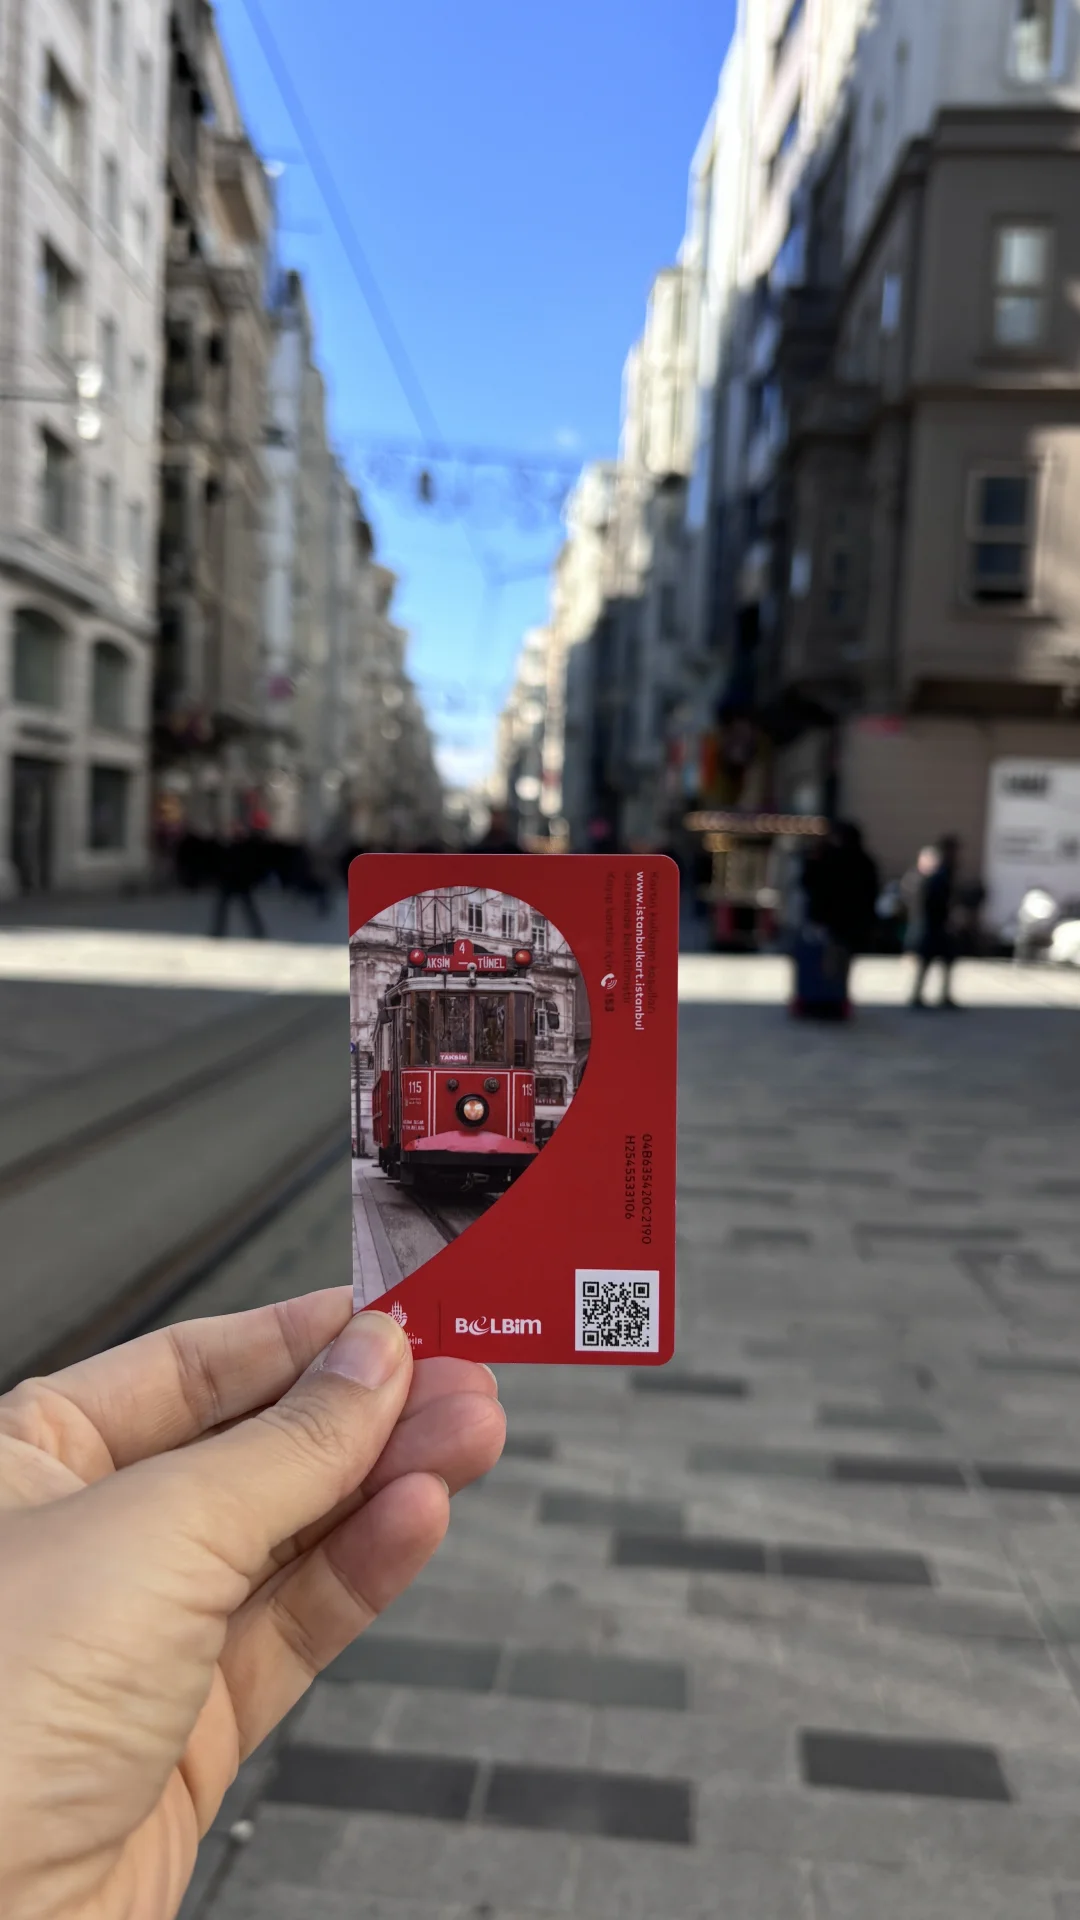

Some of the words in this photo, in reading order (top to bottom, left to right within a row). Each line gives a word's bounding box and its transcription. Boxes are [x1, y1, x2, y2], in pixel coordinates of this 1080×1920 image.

[459, 942, 466, 954] 4
[634, 871, 646, 1031] www.istanbulkart.istanbul
[426, 957, 450, 969] AKSİM
[477, 957, 505, 969] TÜNEL
[604, 993, 615, 1012] 153
[408, 1081, 422, 1094] 115
[625, 1135, 636, 1220] H2545533106
[641, 1133, 653, 1245] 04B635420C2190
